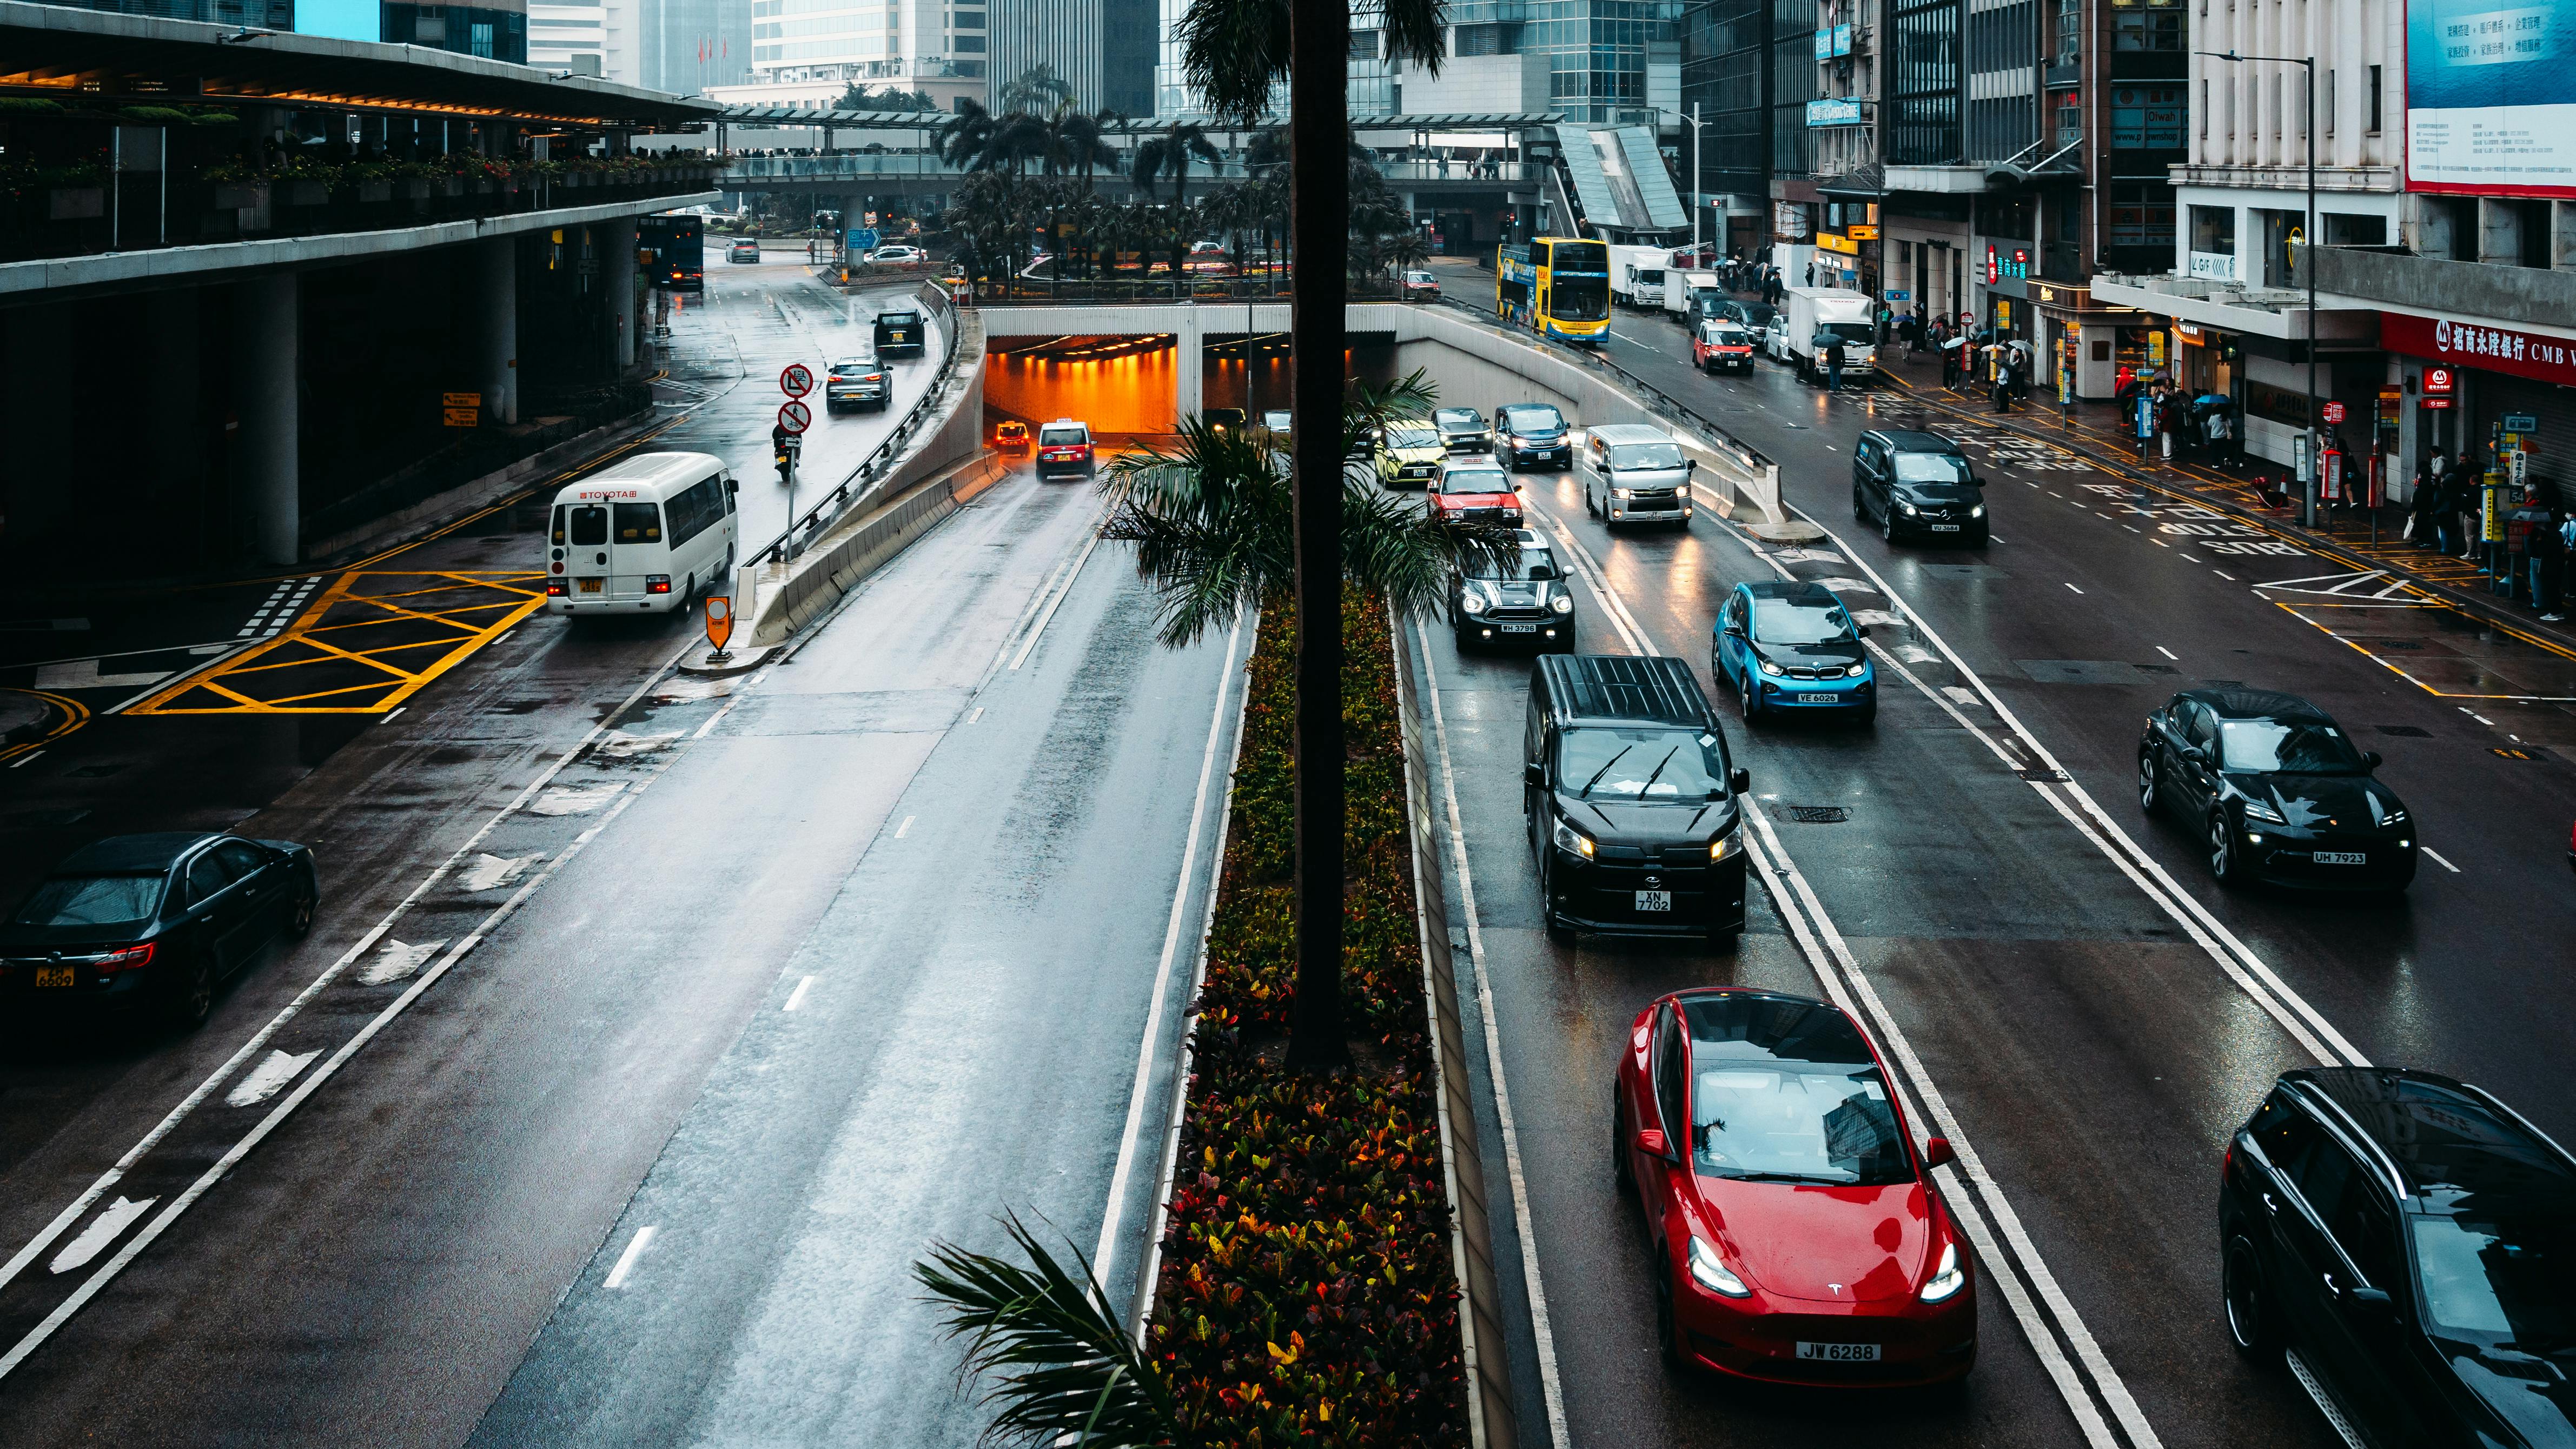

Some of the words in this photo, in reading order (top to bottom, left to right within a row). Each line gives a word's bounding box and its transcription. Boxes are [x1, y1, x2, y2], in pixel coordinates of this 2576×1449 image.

[2515, 16, 2540, 30] 企業管理
[2480, 42, 2504, 56] 家族治理
[2515, 38, 2540, 52] 增值服務
[2148, 111, 2175, 122] Oiwah
[2453, 324, 2525, 361] 招商永隆銀行
[2531, 343, 2564, 364] CMB
[1987, 450, 2072, 459] STOP
[2015, 462, 2094, 471] BUS
[2511, 492, 2524, 503] 54
[2157, 522, 2270, 536] STOP
[2198, 541, 2308, 556] BUS
[2315, 853, 2330, 862] UH
[2334, 854, 2364, 863] 7923
[1646, 892, 1661, 901] XN
[1638, 901, 1668, 910] 7702
[39, 976, 72, 986] 6609
[1804, 1344, 1824, 1359] JW
[1827, 1345, 1872, 1360] 6288
